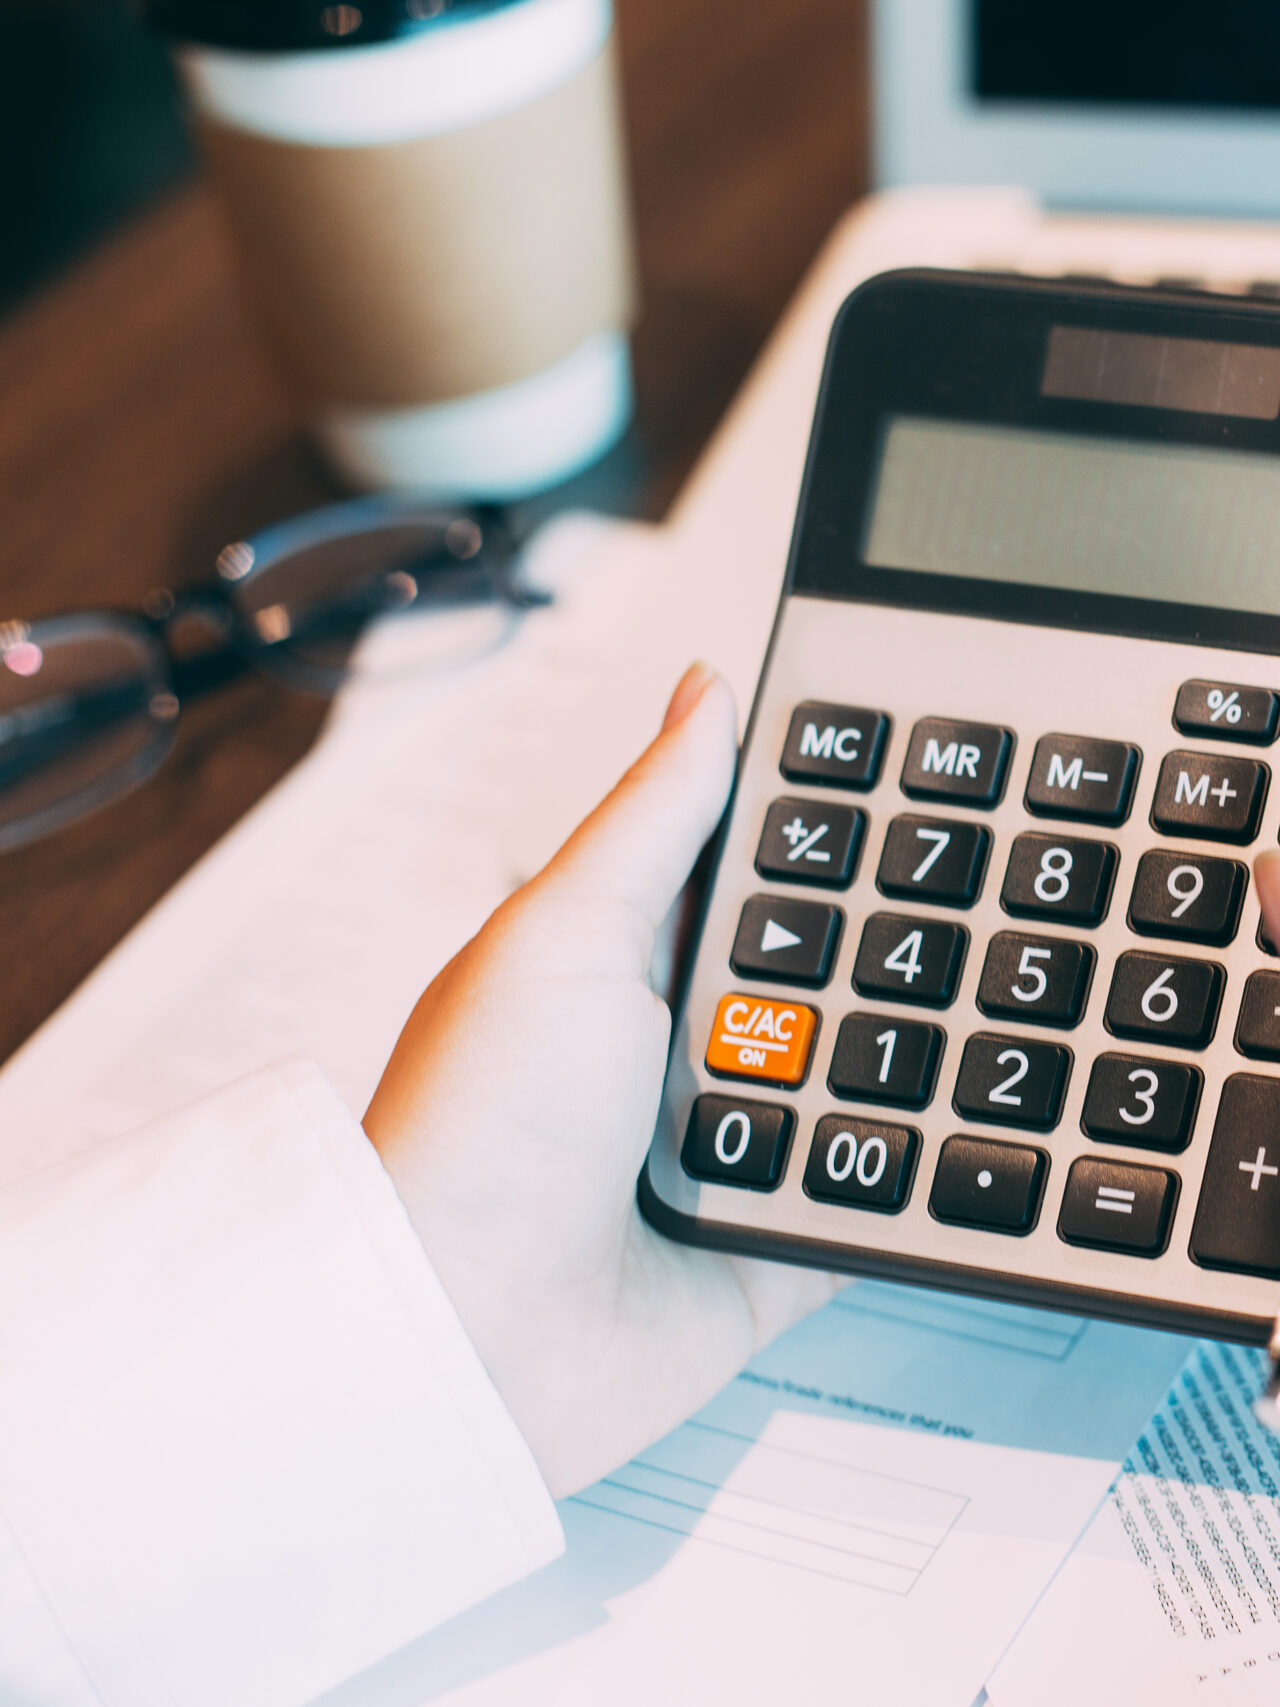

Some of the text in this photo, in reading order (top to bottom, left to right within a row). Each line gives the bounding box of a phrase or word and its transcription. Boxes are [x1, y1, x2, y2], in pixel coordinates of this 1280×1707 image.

[1207, 689, 1242, 724] %
[799, 723, 862, 761] MC
[921, 738, 981, 778] MR
[1174, 761, 1237, 808] M+
[912, 828, 950, 882] 7
[1034, 847, 1073, 902] 8
[1167, 865, 1204, 918] 9
[884, 930, 923, 983] 4
[1011, 946, 1052, 1002] 5
[1141, 968, 1178, 1022] 6
[723, 1001, 796, 1043] C/AC
[738, 1048, 768, 1069] ON
[876, 1030, 897, 1083] 1
[988, 1049, 1029, 1106] 2
[1118, 1069, 1159, 1125] 3
[715, 1111, 751, 1164] 0
[826, 1131, 887, 1187] 00
[1238, 1146, 1279, 1191] +
[909, 1411, 942, 1431] that
